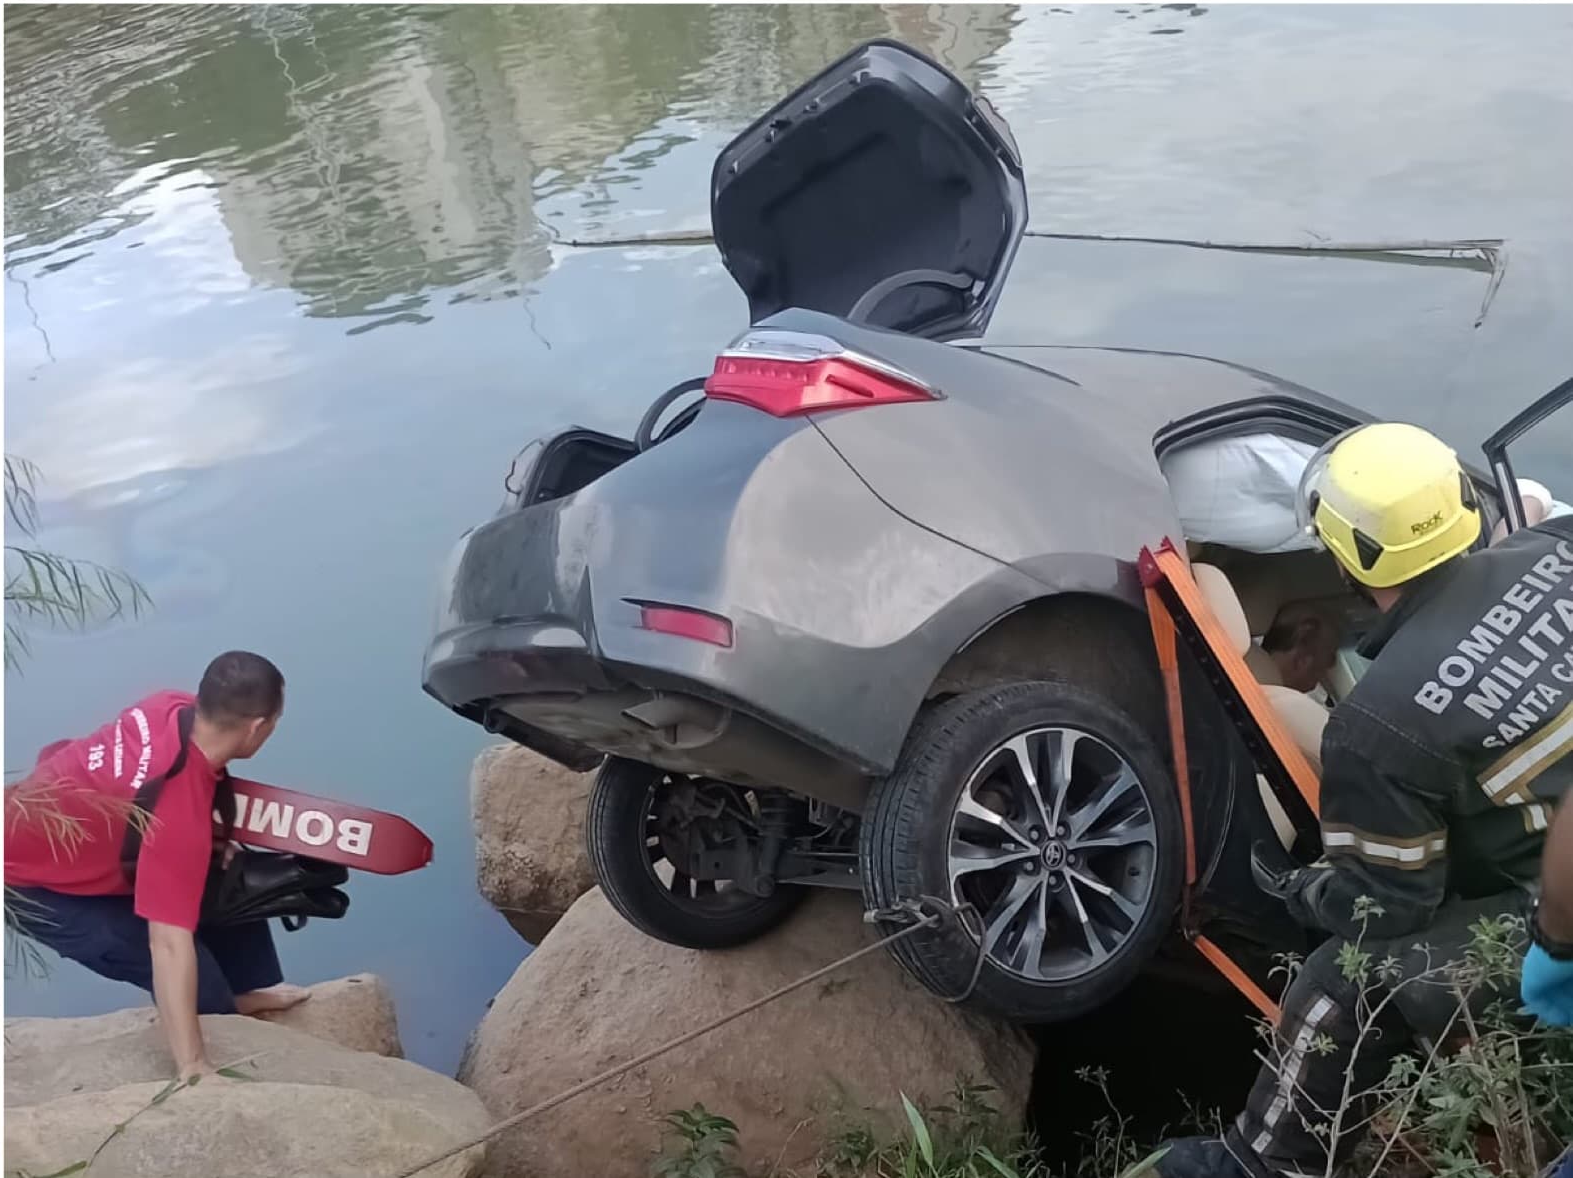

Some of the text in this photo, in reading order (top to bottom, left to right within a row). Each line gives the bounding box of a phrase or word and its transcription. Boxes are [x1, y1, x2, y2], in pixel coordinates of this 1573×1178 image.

[1463, 584, 1573, 720] MILITA
[1482, 682, 1563, 749] SANTA
[88, 744, 105, 771] 193
[130, 745, 152, 789] MILITAR
